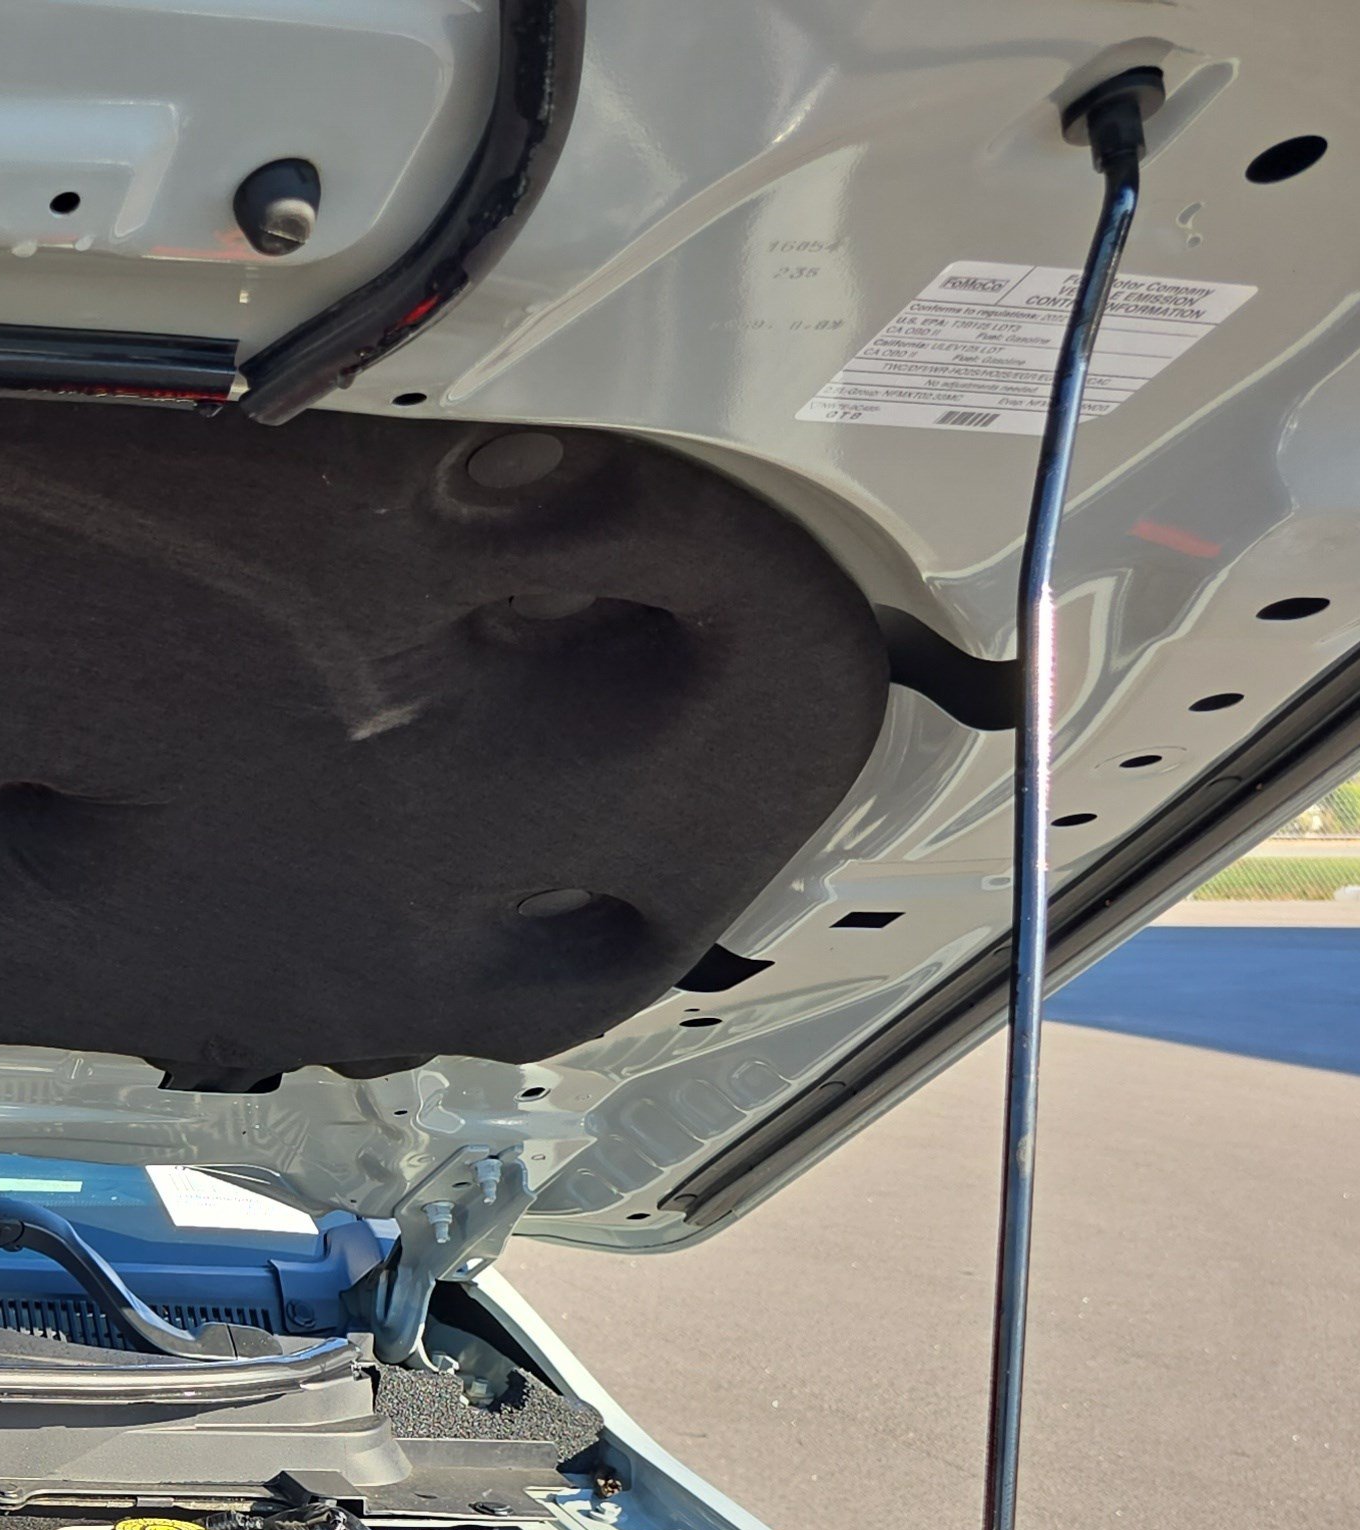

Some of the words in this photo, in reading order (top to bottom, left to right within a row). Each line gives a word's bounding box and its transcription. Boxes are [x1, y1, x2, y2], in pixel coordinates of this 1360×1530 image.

[941, 277, 1004, 292] FoMoCo
[1146, 281, 1216, 297] Company
[1126, 291, 1202, 307] EMISSION
[909, 303, 962, 313] Conforms
[966, 307, 976, 315] to
[976, 308, 1039, 320] regulations:
[1005, 333, 1052, 345] Gasoline
